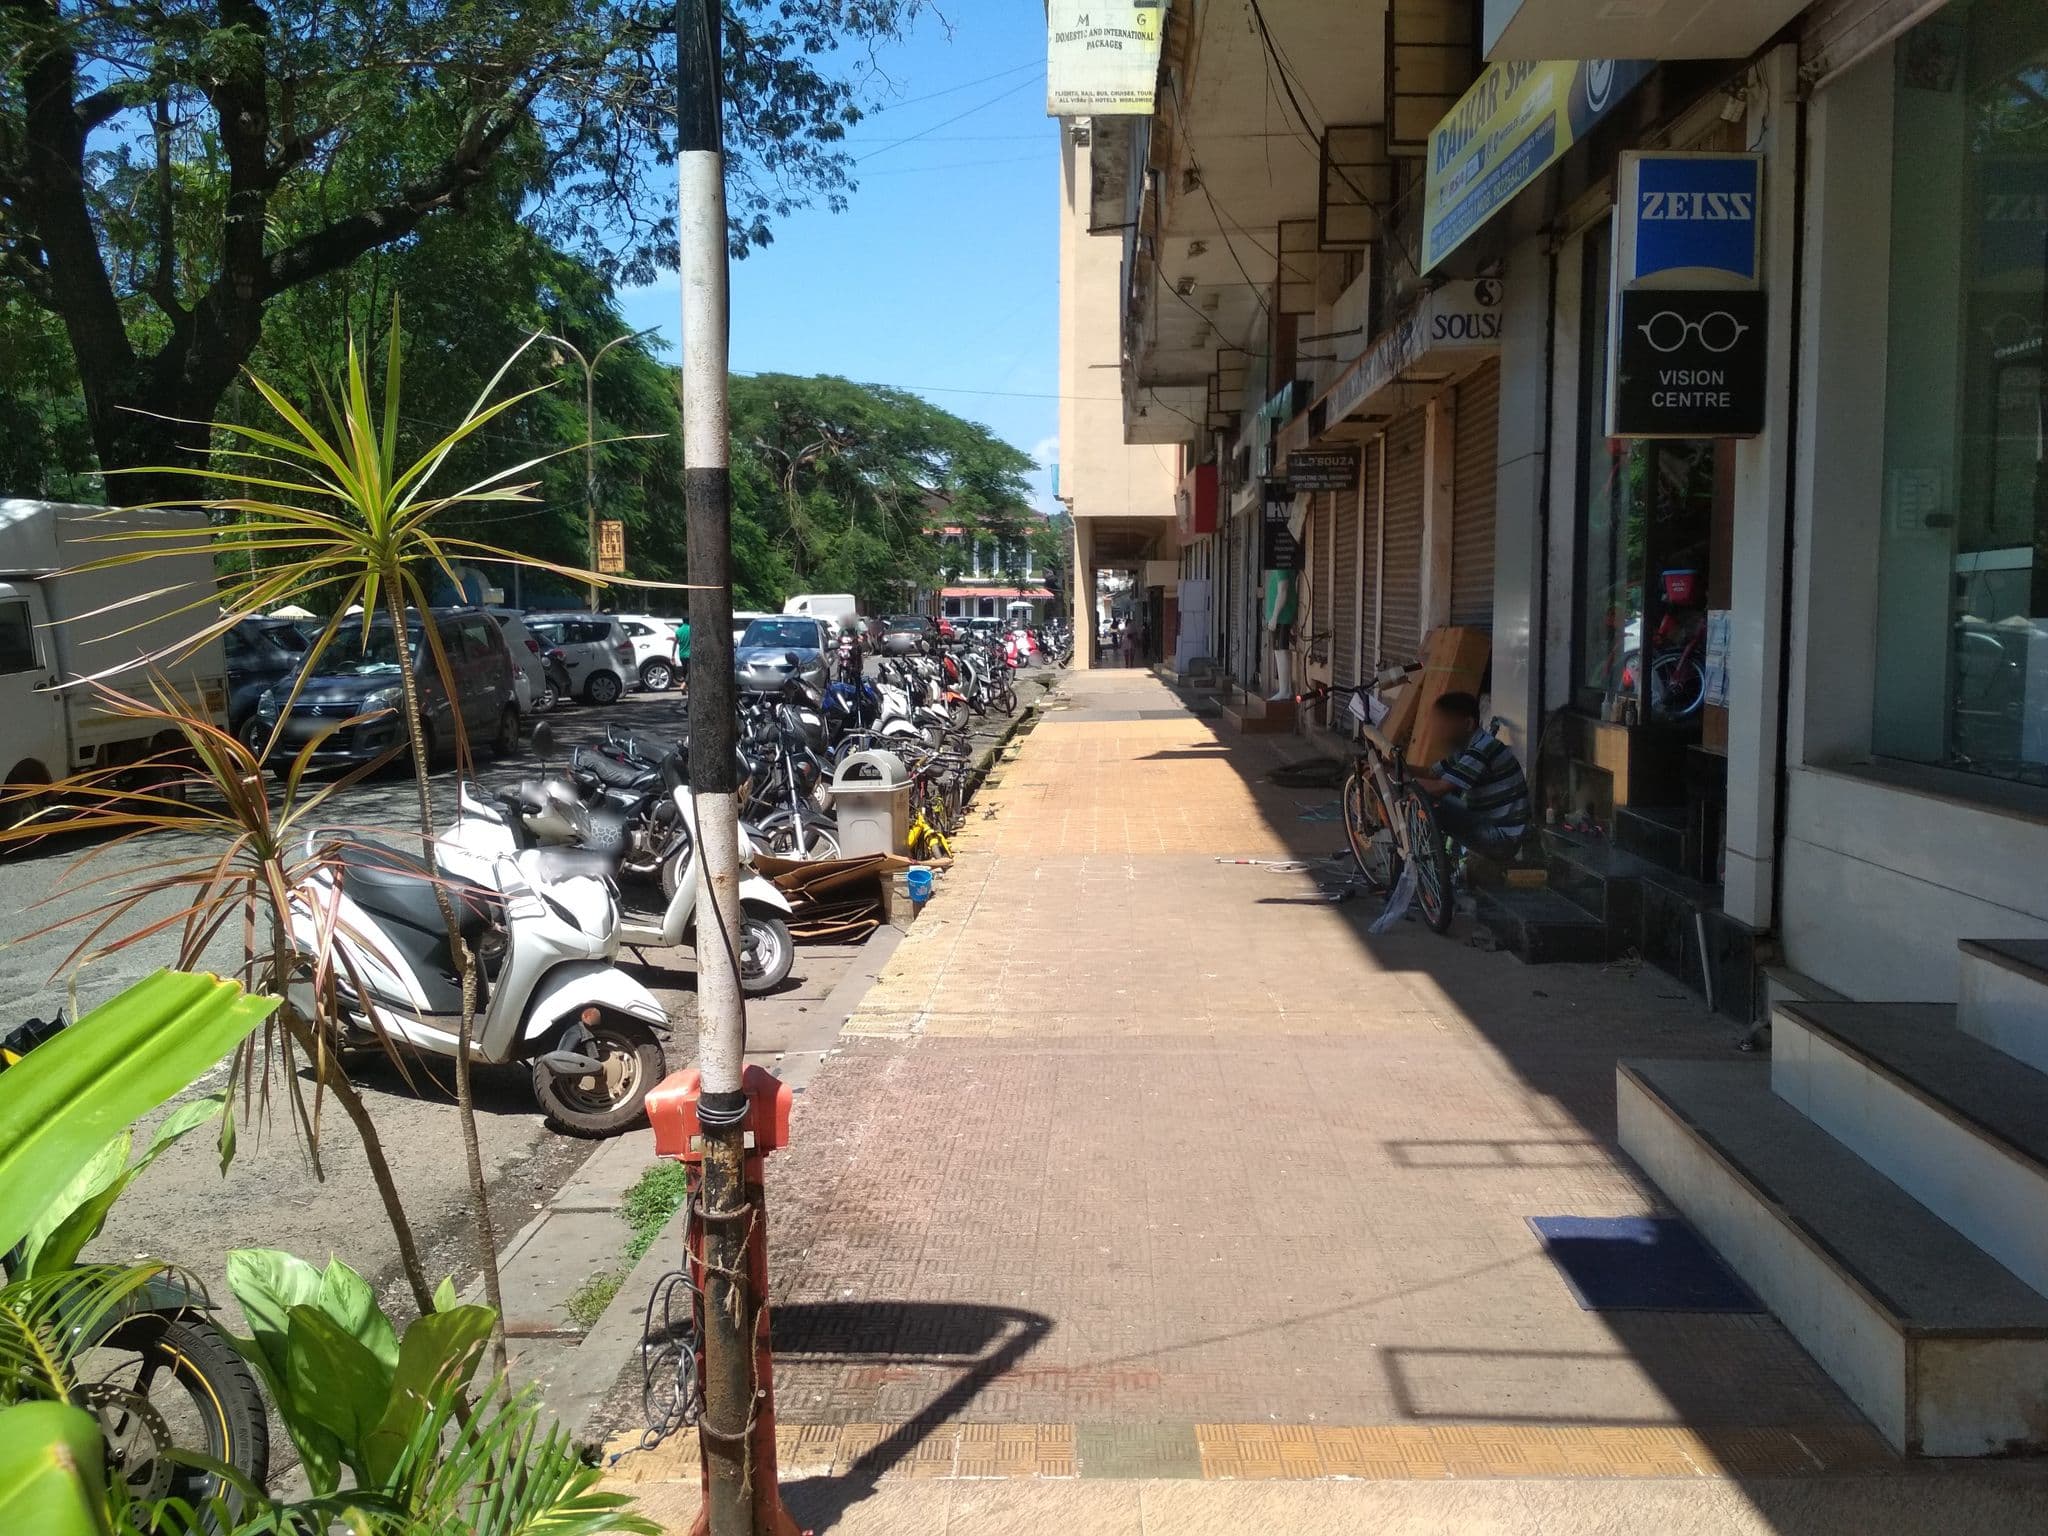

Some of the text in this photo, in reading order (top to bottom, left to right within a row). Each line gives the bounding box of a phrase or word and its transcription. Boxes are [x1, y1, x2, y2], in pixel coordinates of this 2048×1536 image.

[1055, 28, 1155, 43] DOMESTIC AND INTERNATIONAL
[1086, 39, 1123, 50] PACKAGES
[1641, 192, 1752, 220] ZEISS
[1659, 370, 1724, 386] VISION
[1651, 391, 1731, 408] CENTRE
